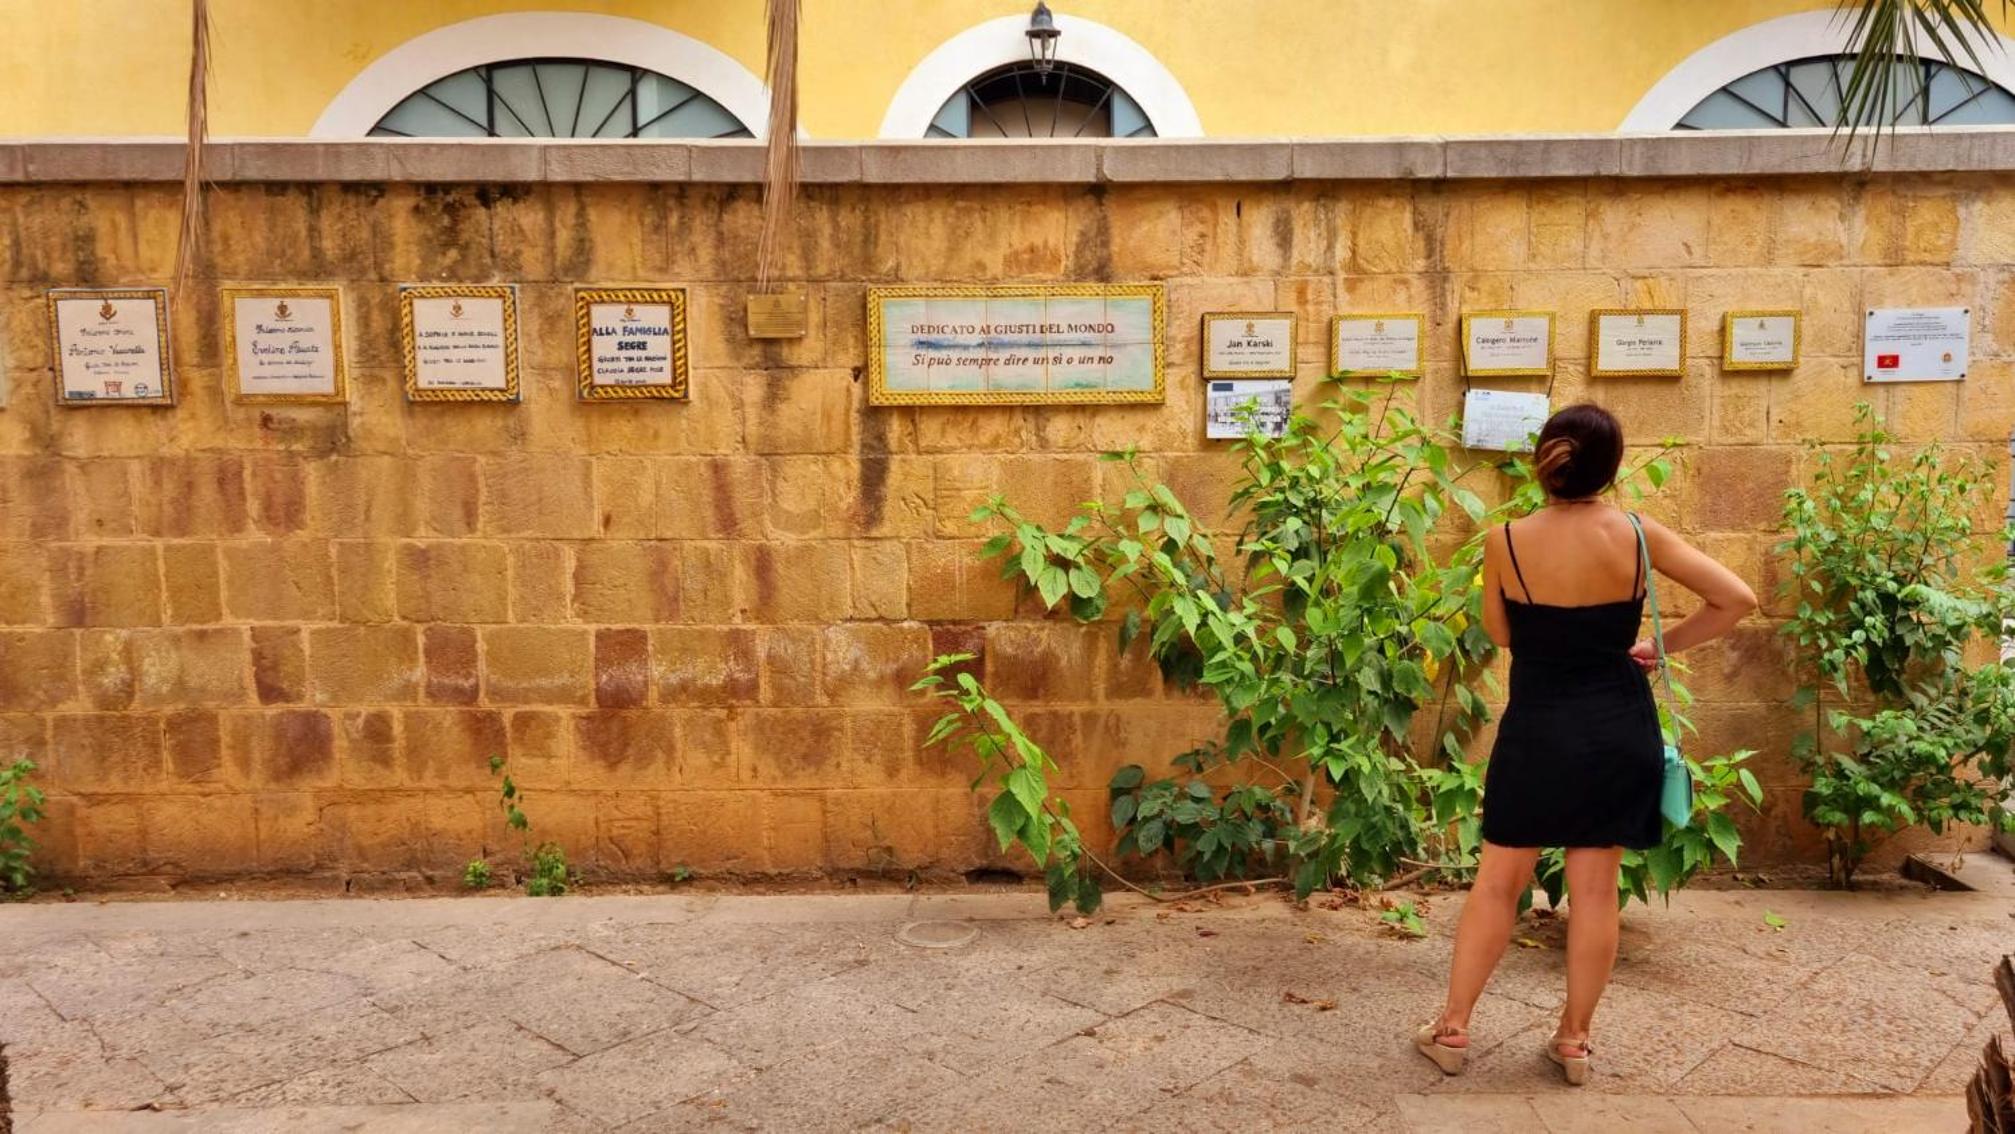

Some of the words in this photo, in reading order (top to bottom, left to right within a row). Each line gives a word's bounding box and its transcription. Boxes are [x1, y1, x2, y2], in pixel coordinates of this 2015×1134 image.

[591, 327, 618, 336] ALLA
[622, 326, 669, 336] FAMIGLIA
[911, 324, 976, 334] DEDICATO
[978, 324, 991, 335] AI
[994, 323, 1037, 334] GIUSTI
[1039, 323, 1064, 334] DEL
[1067, 323, 1115, 334] MONDO
[617, 341, 648, 351] SEGRE
[1226, 339, 1243, 349] Jan
[1246, 339, 1273, 348] Karski
[927, 354, 952, 369] può
[955, 356, 1000, 369] sempre
[1003, 353, 1029, 366] dire
[1032, 356, 1049, 365] un
[1051, 352, 1063, 366] sì
[1066, 356, 1074, 365] o
[1078, 355, 1094, 365] un
[1097, 355, 1114, 365] no
